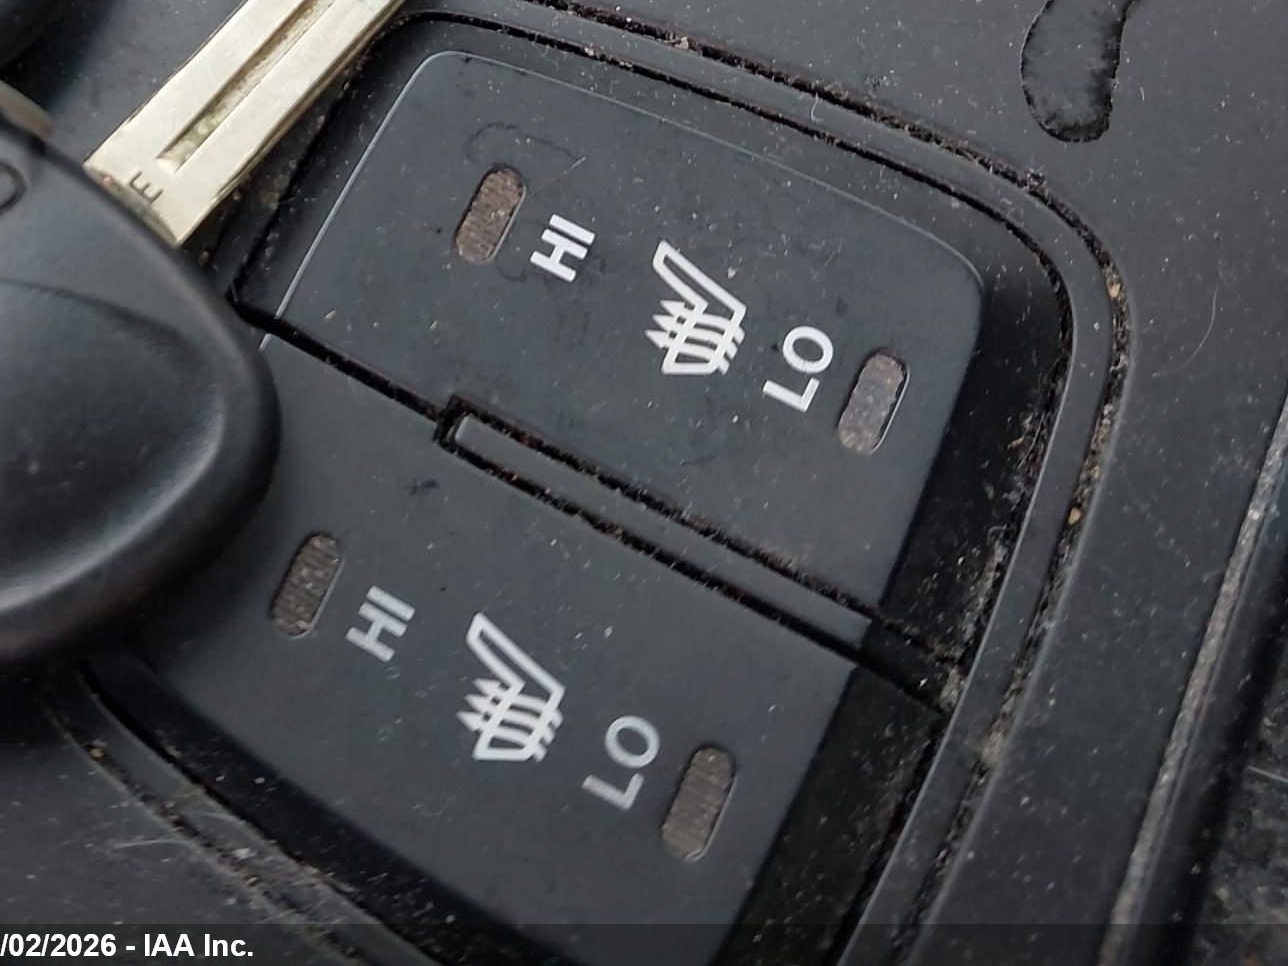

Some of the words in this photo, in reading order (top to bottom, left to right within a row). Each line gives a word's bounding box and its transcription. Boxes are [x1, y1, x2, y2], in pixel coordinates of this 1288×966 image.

[529, 214, 596, 283] HI
[762, 325, 835, 412] LO
[345, 585, 416, 662] HI
[582, 715, 661, 810] LO
